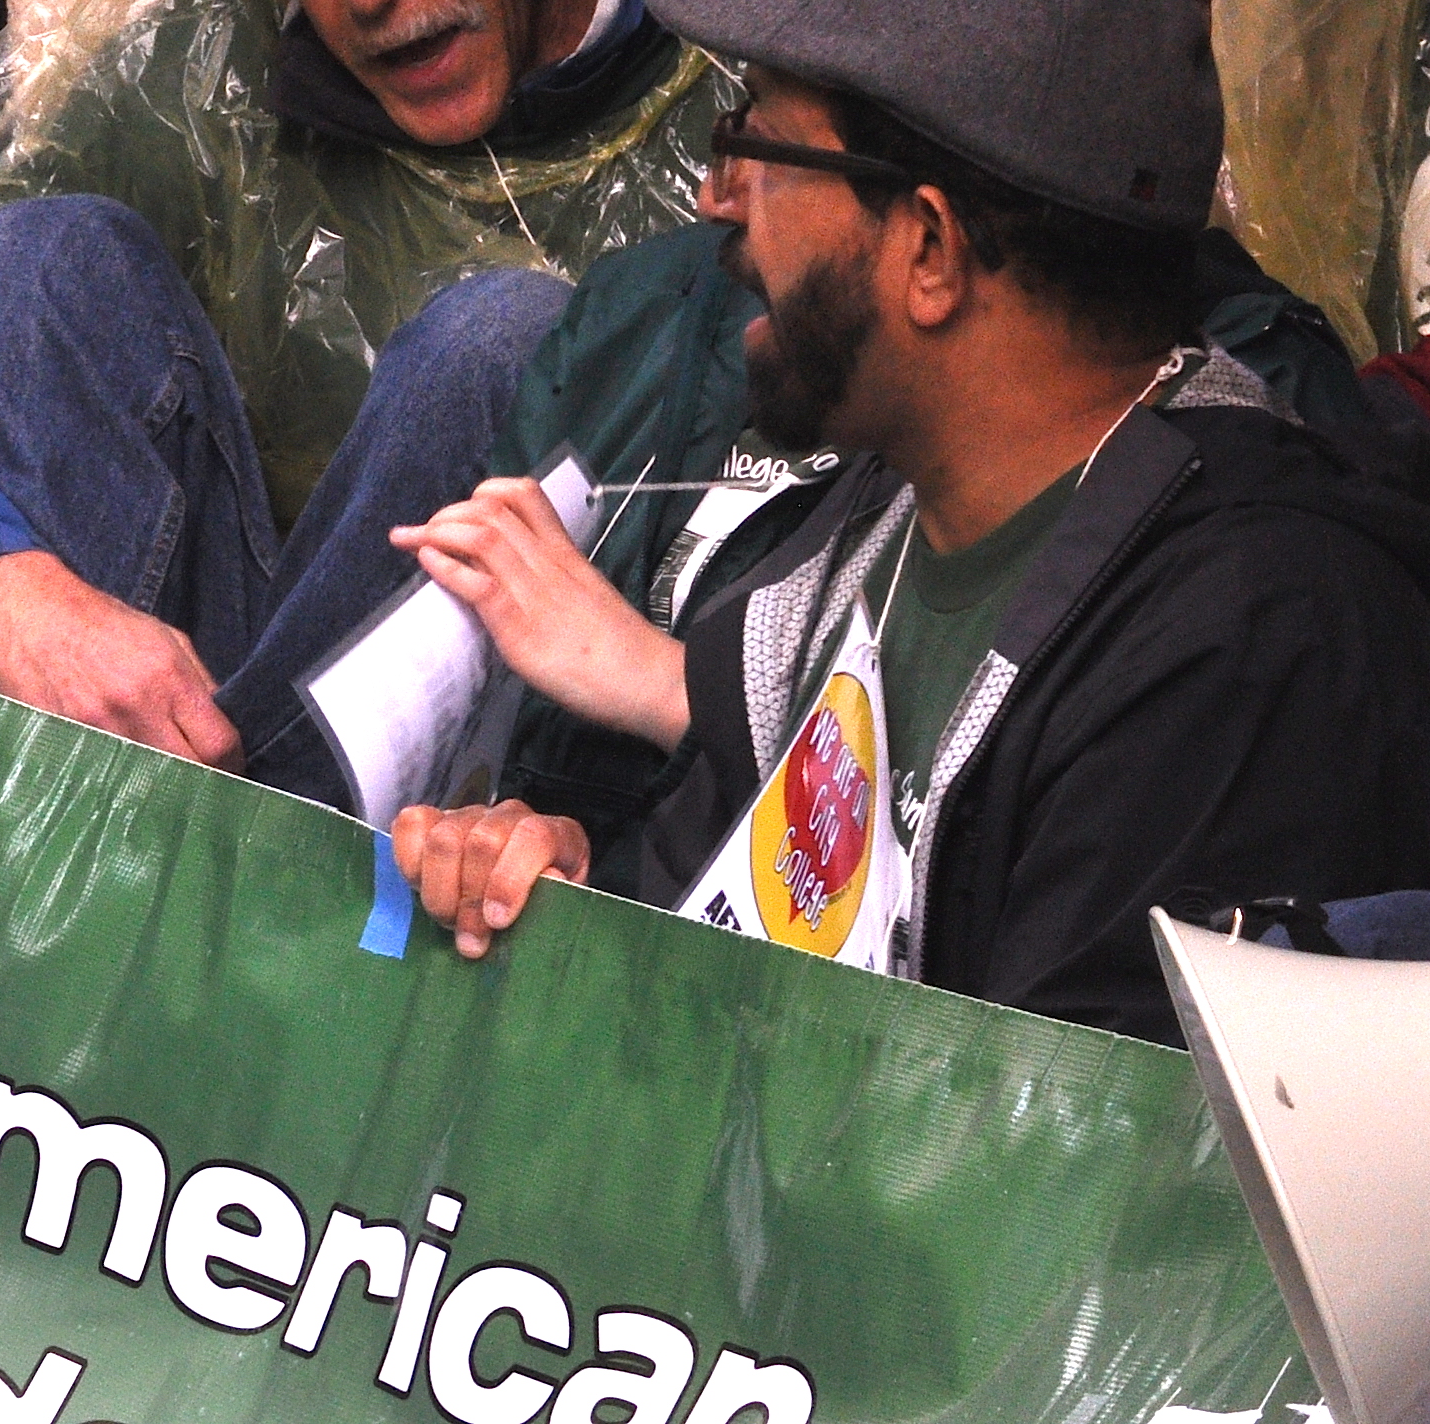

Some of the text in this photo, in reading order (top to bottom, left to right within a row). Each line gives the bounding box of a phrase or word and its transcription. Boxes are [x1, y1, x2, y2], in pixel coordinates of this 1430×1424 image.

[809, 704, 838, 763] We
[808, 783, 842, 867] City
[774, 825, 829, 932] College
